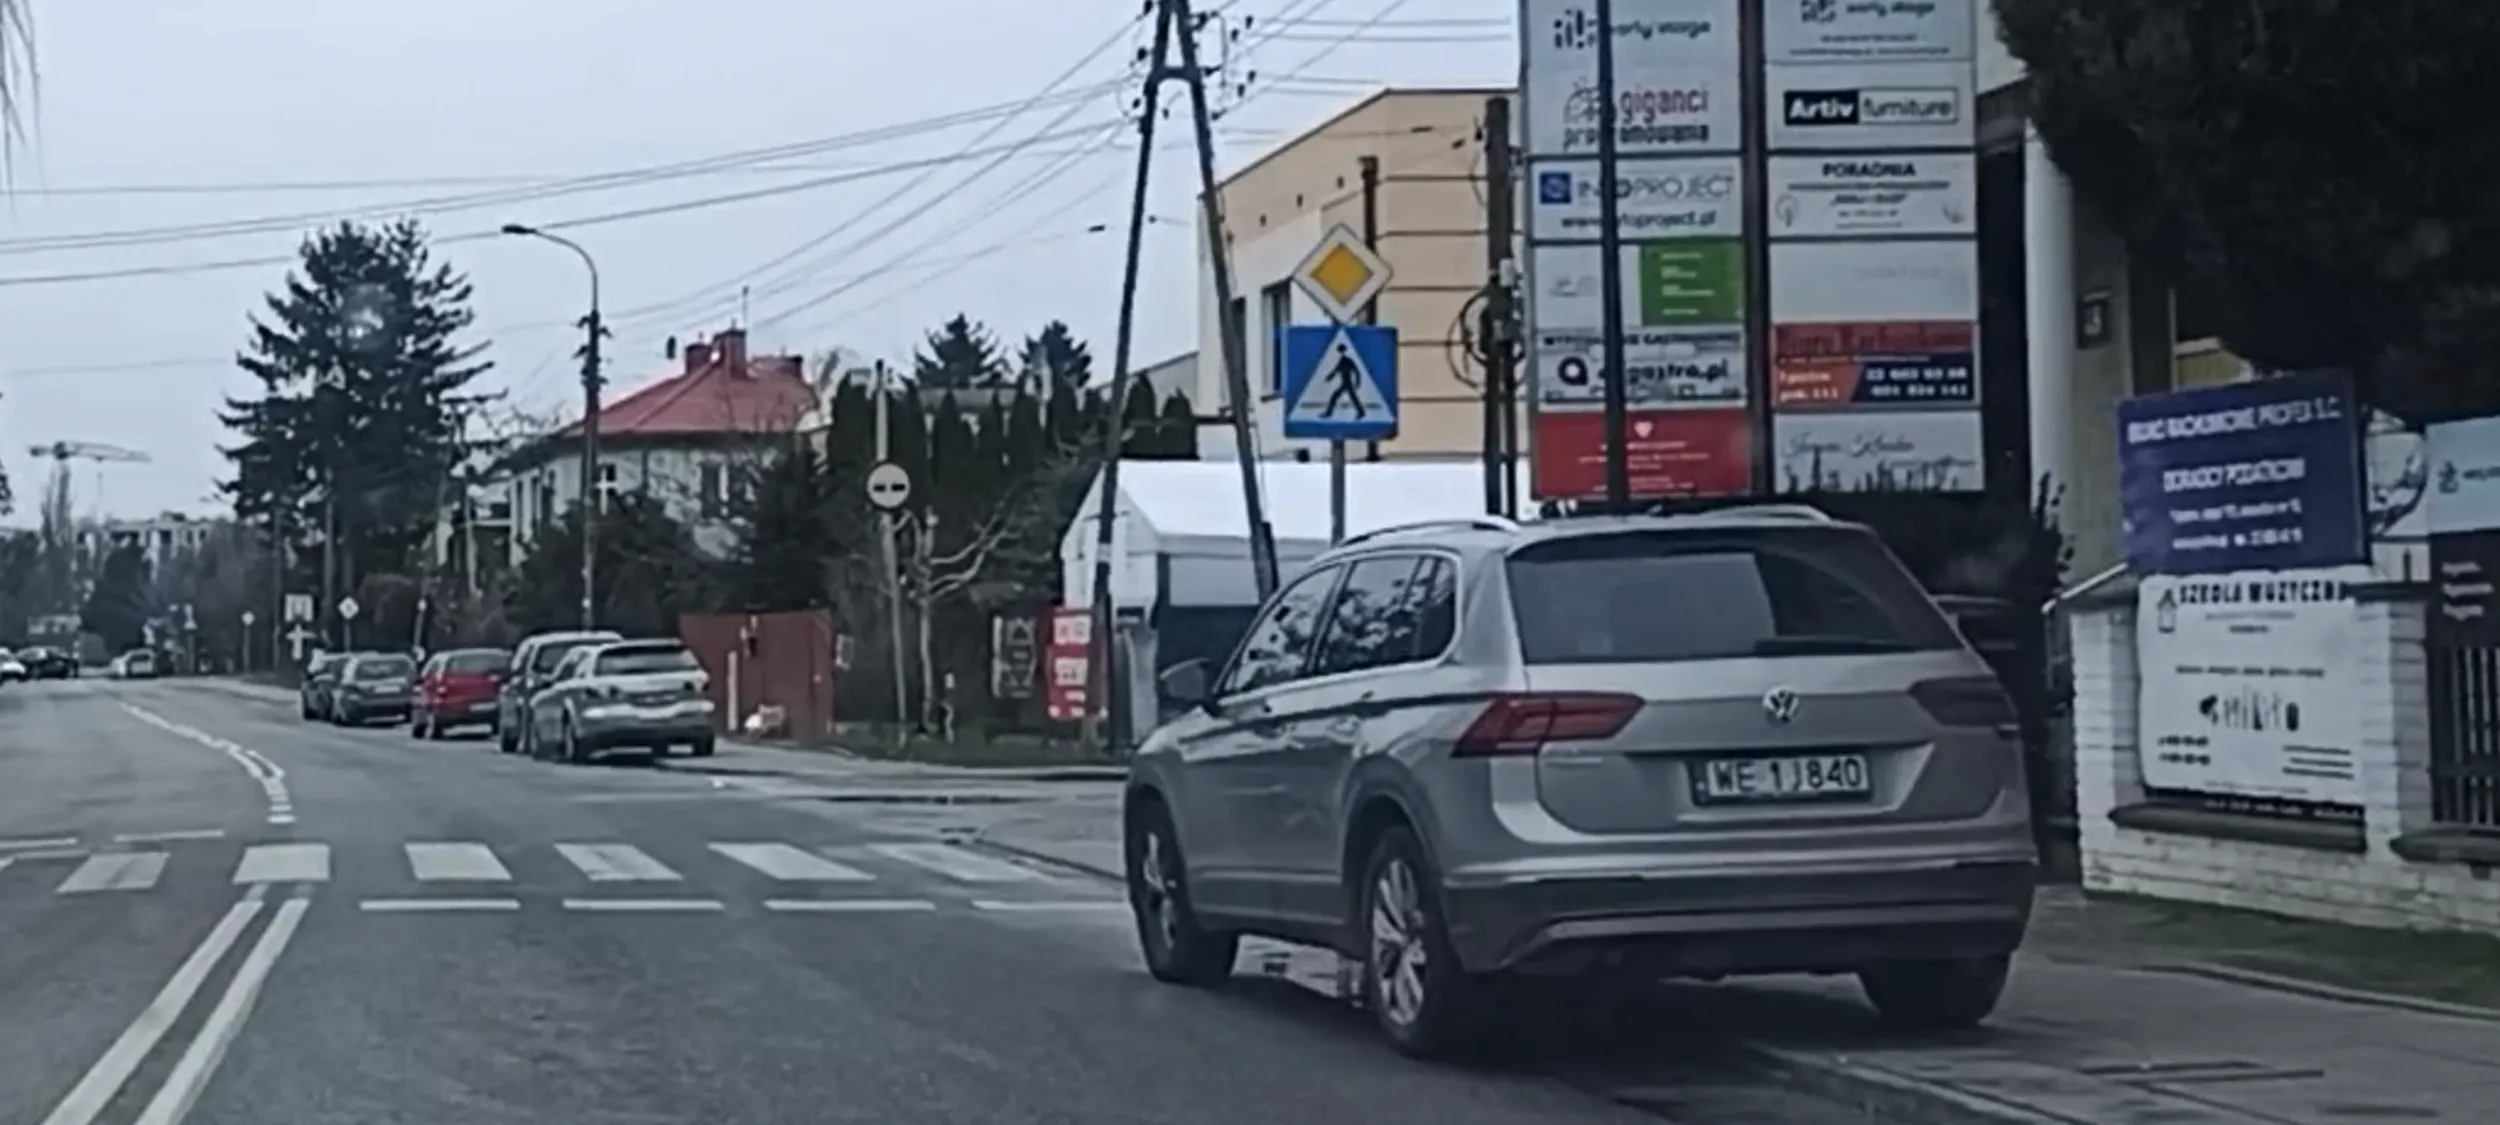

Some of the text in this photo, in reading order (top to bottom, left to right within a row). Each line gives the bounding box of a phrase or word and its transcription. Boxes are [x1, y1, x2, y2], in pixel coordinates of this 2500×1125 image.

[1620, 81, 1708, 123] giganci
[1789, 95, 1953, 119] Artiv furniture
[1563, 124, 1710, 150] proamowania
[1822, 162, 1917, 176] PORADNIA
